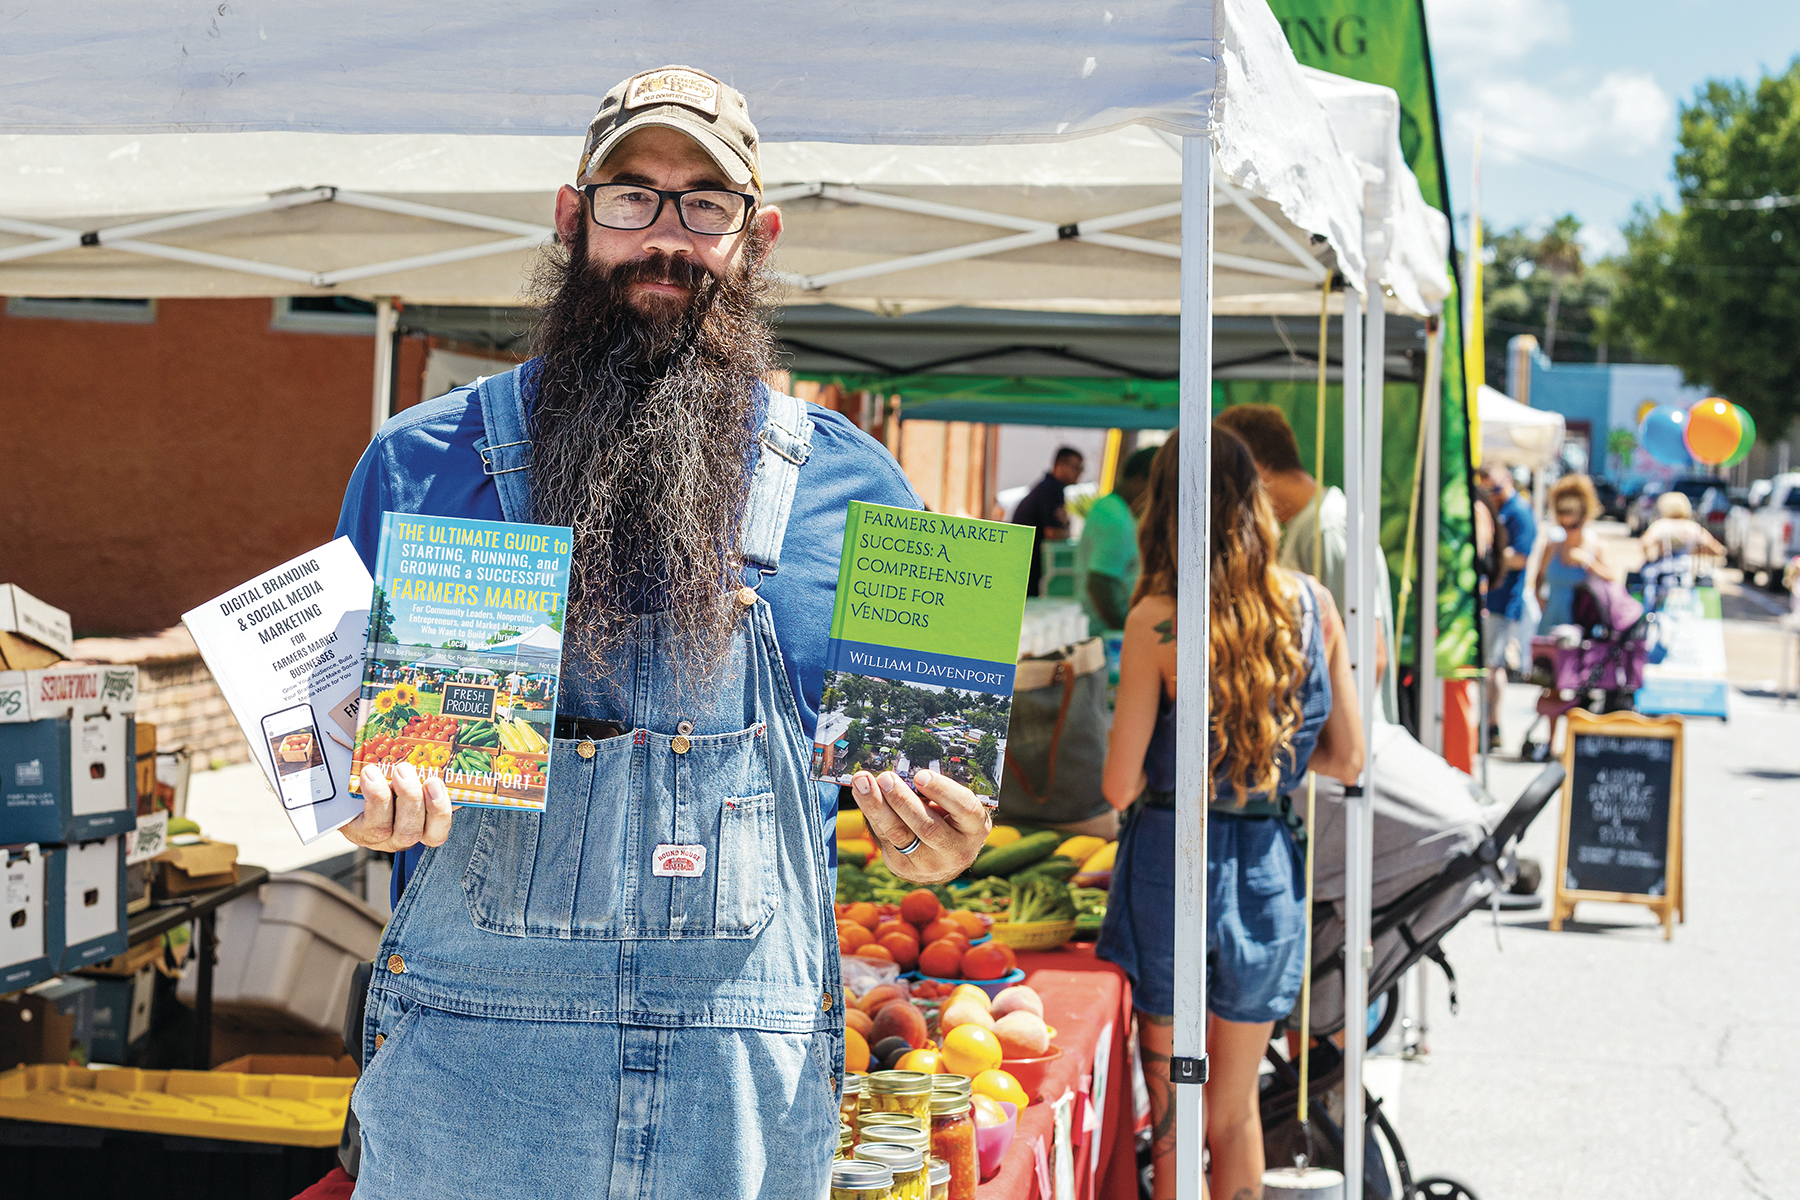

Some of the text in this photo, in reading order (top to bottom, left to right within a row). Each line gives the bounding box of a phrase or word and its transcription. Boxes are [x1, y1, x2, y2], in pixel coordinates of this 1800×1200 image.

[398, 523, 568, 555] THE ULTIMATE GUIDE to
[864, 510, 1008, 544] FARMERS MARKET
[401, 543, 559, 571] STARTING, RUNNING, and
[859, 534, 951, 563] SUCCESS: A
[220, 559, 320, 616] DIGITAL BRANDING
[400, 559, 556, 587] GROWING a SUCCESSFUL
[856, 557, 993, 589] COMPREHENSIVE
[237, 580, 324, 631] & SOCIAL MEDIA
[391, 578, 561, 613] FARMERS MARKET
[853, 580, 945, 607] GUIDE FOR
[258, 603, 323, 644] MARKETING
[409, 613, 460, 628] Entrepreneurs,
[461, 619, 472, 628] and
[475, 621, 500, 631] Market
[412, 604, 535, 624] For Community Leaders, Nonprofits,
[850, 601, 930, 628] VENDORS
[290, 632, 307, 646] FOR
[421, 625, 437, 635] Who
[440, 626, 457, 636] Want
[458, 628, 466, 637] to
[467, 629, 486, 639] Build
[447, 639, 465, 648] Local
[272, 631, 339, 672] FARMERS MARKET
[289, 649, 336, 679] BUSINESSES
[282, 683, 298, 694] Grow
[297, 676, 311, 686] Your
[338, 654, 353, 665] Build
[283, 691, 297, 702] Your
[315, 676, 326, 686] and
[325, 669, 342, 680] Make
[341, 659, 360, 672] Social
[849, 650, 1005, 686] WILLIAM DAVENPORT
[298, 672, 352, 703] Media Work for You
[453, 689, 486, 701] FRESH
[446, 700, 490, 715] PRODUCE
[378, 762, 532, 791] WIAM DAVENPORT
[681, 850, 700, 861] HOUSE
